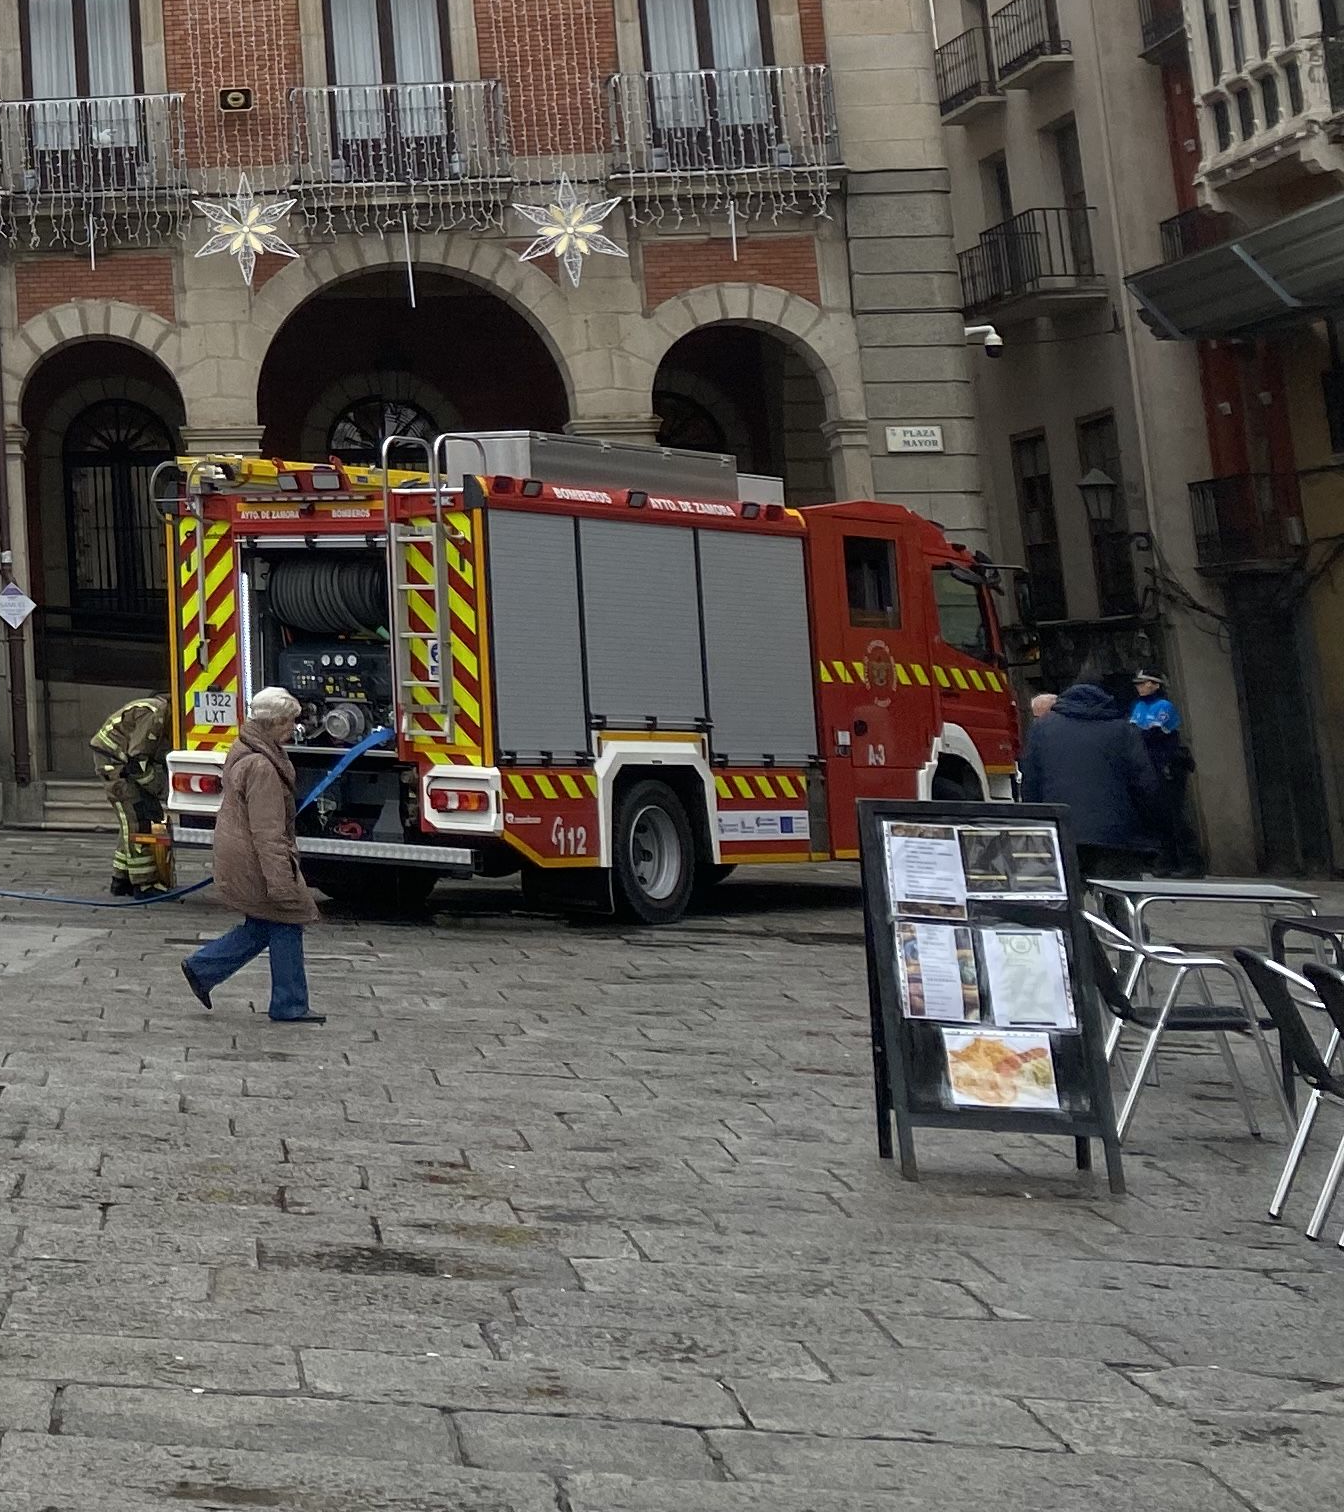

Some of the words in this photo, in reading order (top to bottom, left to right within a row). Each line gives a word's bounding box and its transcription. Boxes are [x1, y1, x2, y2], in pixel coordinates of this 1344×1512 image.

[903, 429, 937, 438] PLAZA
[903, 439, 939, 448] MAYOR
[552, 487, 612, 505] BOMBEROS
[648, 496, 680, 512] AYTO.
[680, 500, 694, 513] DE
[694, 502, 737, 517] ZAMORA
[241, 509, 260, 519] AYTO.
[261, 509, 271, 519] DE
[272, 509, 300, 519] ZAMORA
[331, 508, 371, 518] BOMBEROS
[205, 693, 231, 707] 1322
[205, 709, 226, 723] LXT
[558, 826, 587, 855] 112
